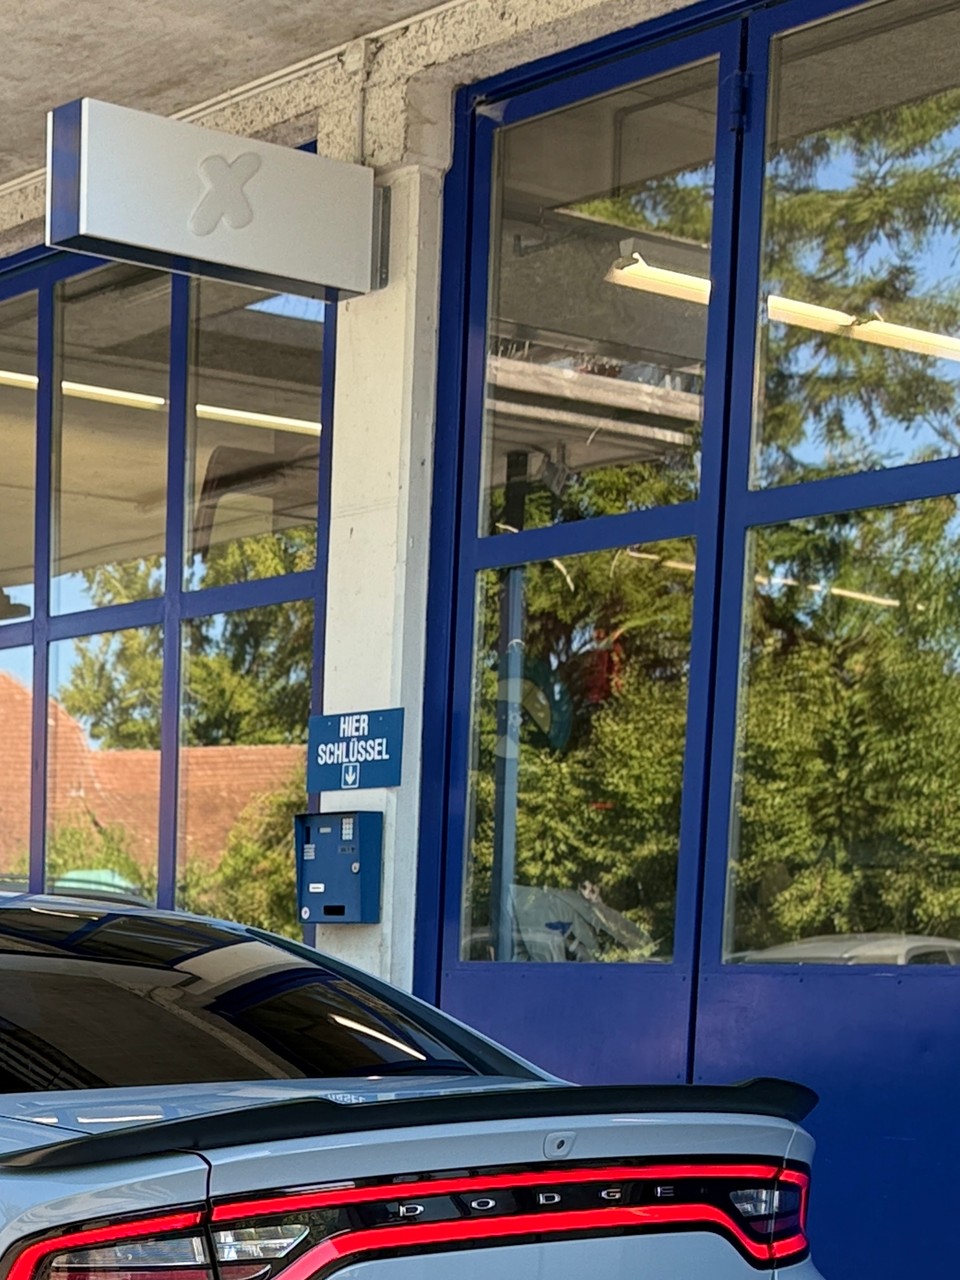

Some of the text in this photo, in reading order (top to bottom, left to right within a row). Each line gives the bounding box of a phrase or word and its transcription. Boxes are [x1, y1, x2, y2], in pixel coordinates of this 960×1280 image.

[339, 714, 369, 738] HIER
[317, 738, 390, 765] SCHLÜSSEL
[399, 1186, 674, 1216] DODGE
